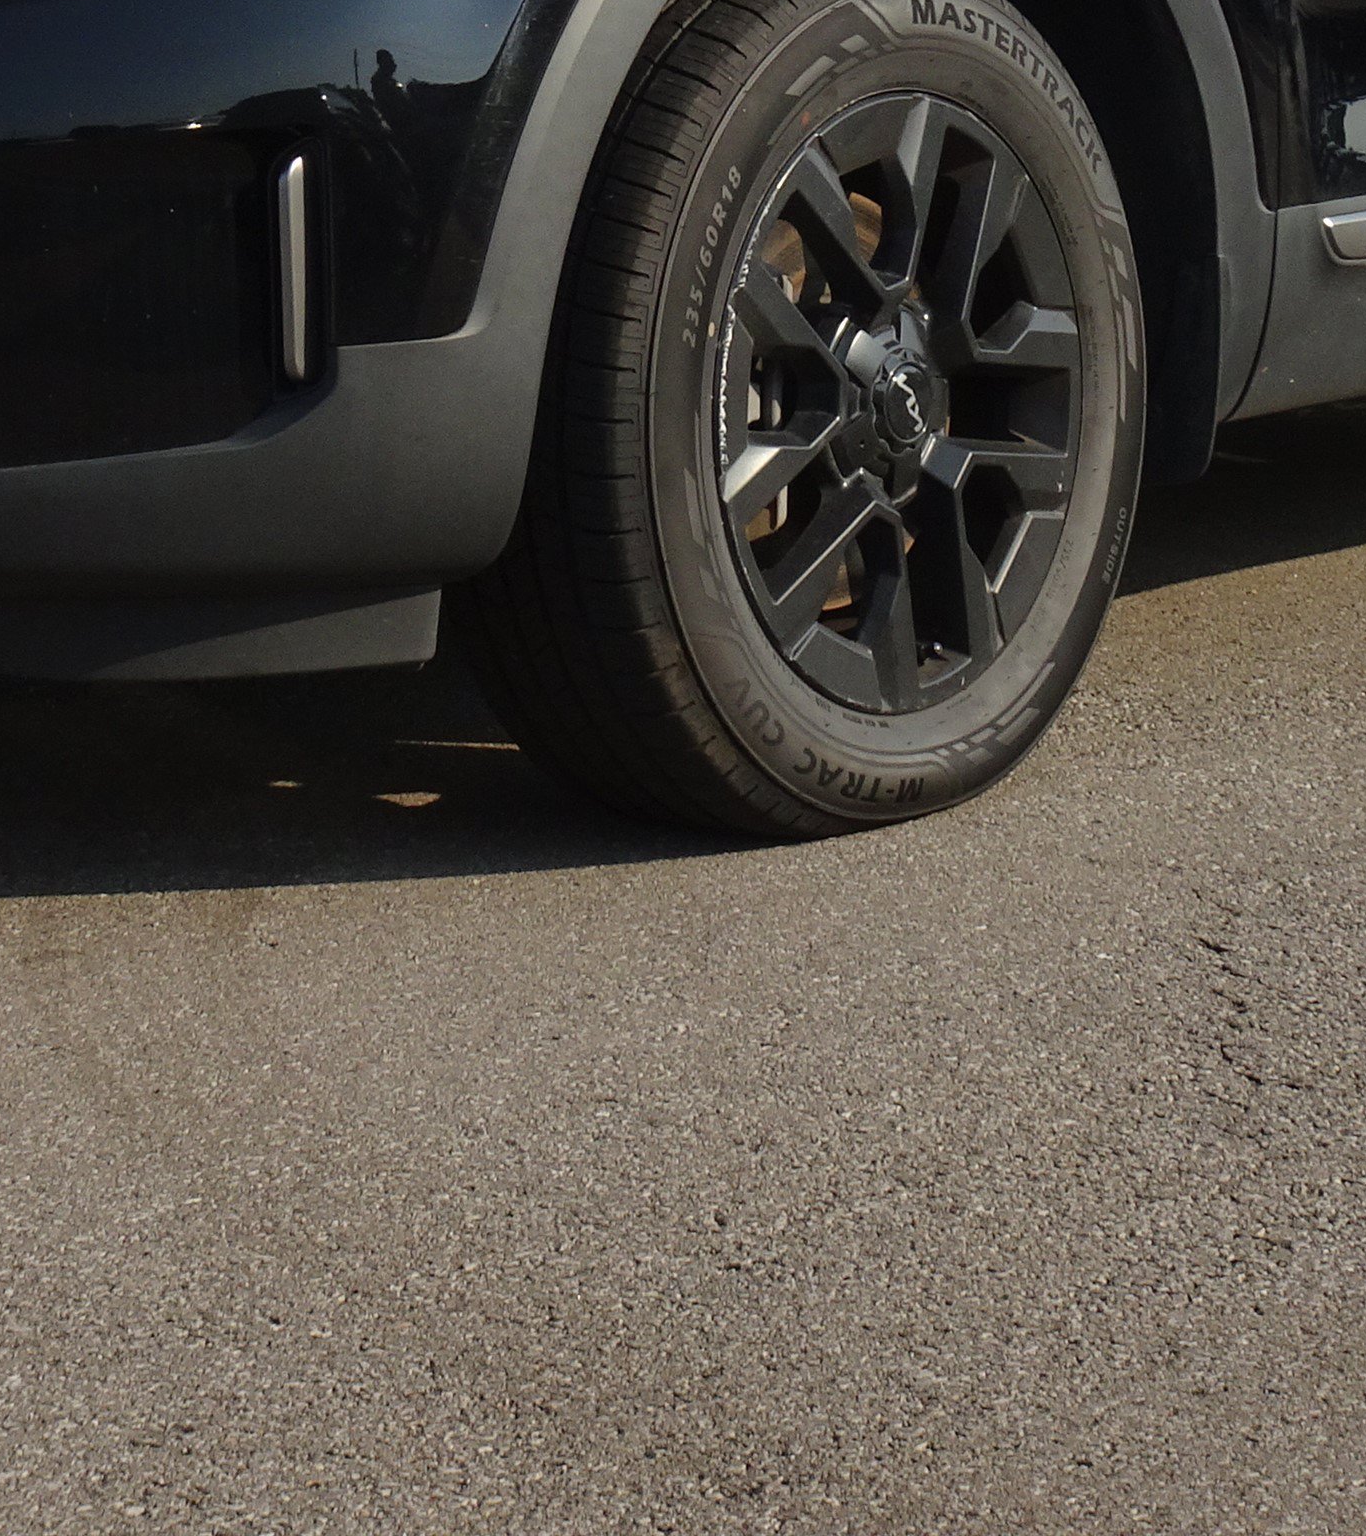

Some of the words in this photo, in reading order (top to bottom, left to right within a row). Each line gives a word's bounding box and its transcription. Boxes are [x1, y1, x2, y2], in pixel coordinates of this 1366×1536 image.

[682, 165, 741, 348] 235/60R18
[1101, 507, 1127, 583] OUTSIDE
[727, 677, 785, 747] CUV
[793, 747, 925, 803] M-TRAC
